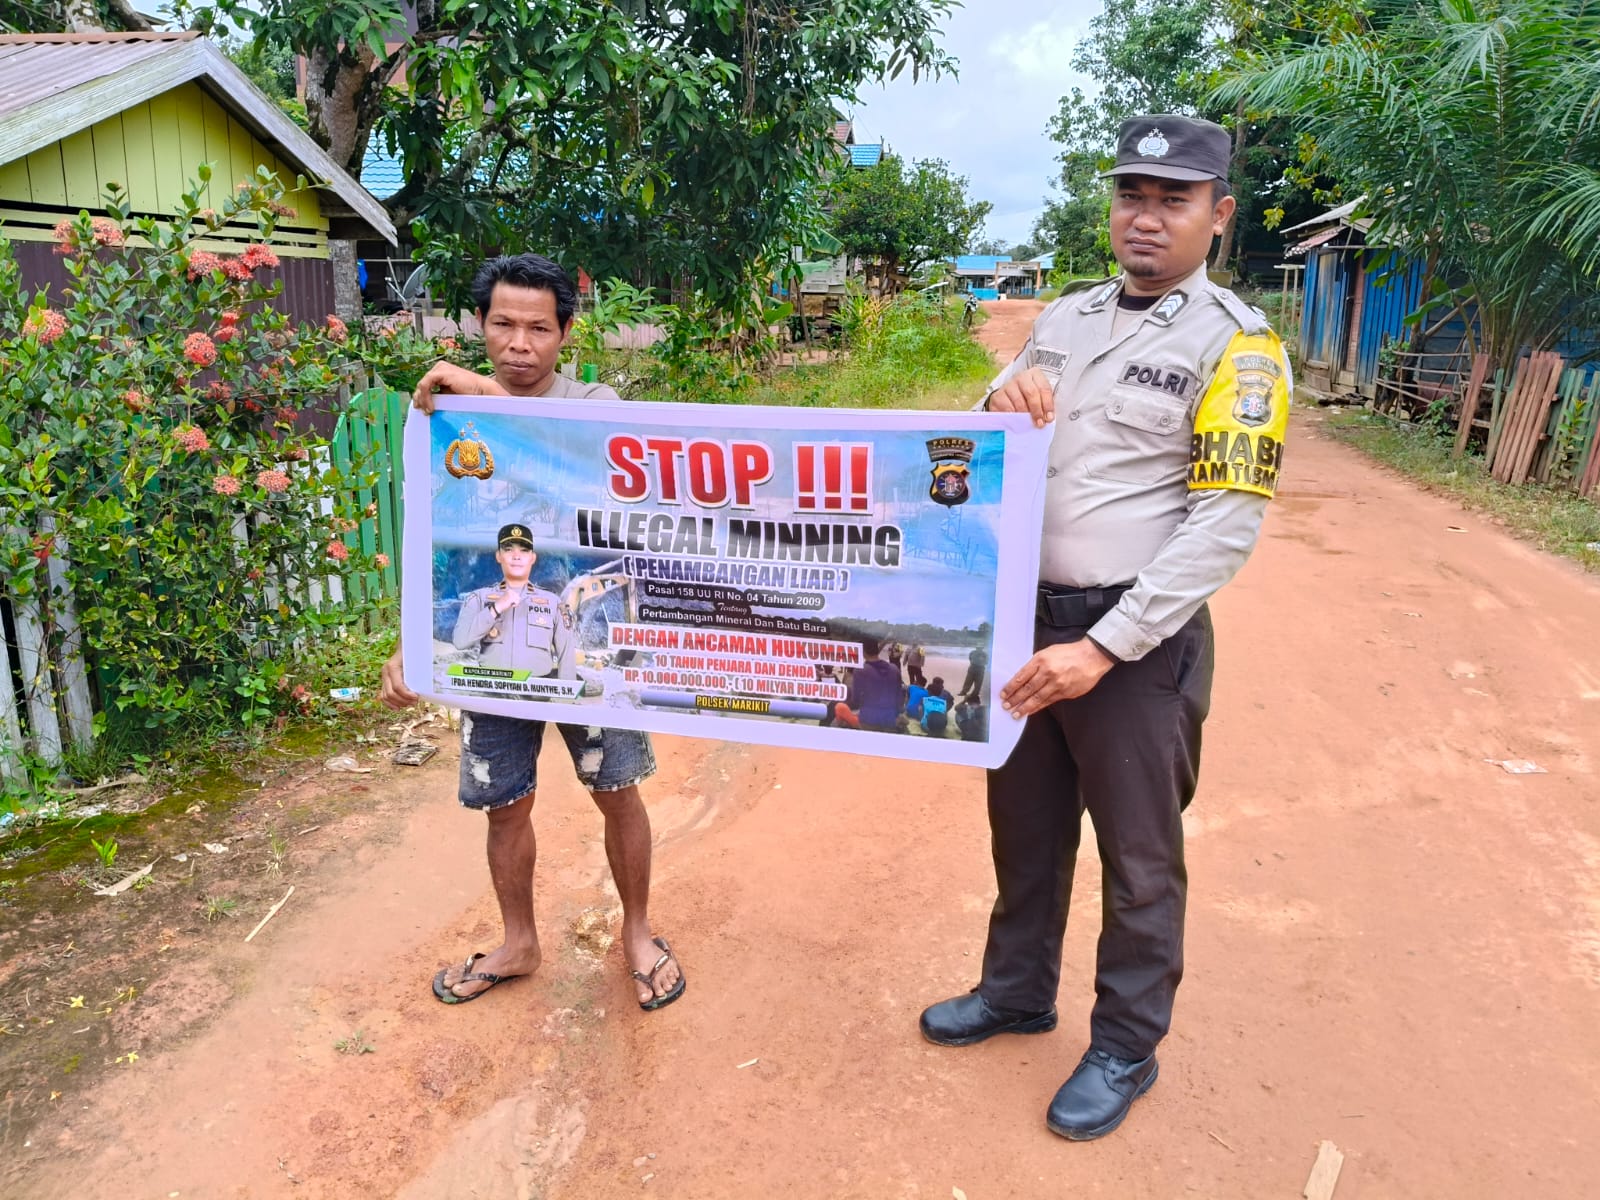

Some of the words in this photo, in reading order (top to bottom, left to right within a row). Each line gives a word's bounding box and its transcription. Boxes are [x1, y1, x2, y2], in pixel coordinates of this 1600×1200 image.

[1123, 364, 1189, 395] POLRI
[1189, 431, 1284, 472] BHABI
[608, 435, 770, 506] STOP
[796, 445, 869, 511] !!!
[1187, 462, 1278, 490] KAMTIBM
[577, 508, 719, 556] ILLEGAL
[728, 518, 902, 567] MINNING
[648, 584, 675, 595] Pasal
[678, 587, 694, 597] 158
[697, 588, 711, 599] UU
[714, 590, 725, 599] RI
[727, 591, 744, 601] No.
[747, 592, 759, 602] 04
[761, 594, 793, 605] Tahun
[796, 596, 821, 607] 2009
[528, 605, 552, 615] POLRI
[642, 608, 713, 624] Pertambangan
[716, 614, 752, 626] Mineral
[754, 617, 774, 628] Dan
[776, 620, 800, 631] Batu
[803, 622, 827, 633] Bara
[612, 626, 679, 650] DENGAN
[682, 631, 767, 656] ANCAMAN
[771, 638, 859, 665] HUKUMAN
[655, 654, 667, 667] 10
[669, 655, 704, 671] TAHUN
[706, 658, 752, 674] PENJARA
[754, 661, 775, 676] DAN
[778, 663, 814, 679] DENDA
[467, 679, 493, 690] HENDRA
[494, 681, 522, 692] SOPIYAN
[624, 669, 640, 682] RP.
[756, 680, 794, 695] MILYAR
[696, 695, 730, 709] POLSEK
[731, 699, 770, 712] MARIKIT
